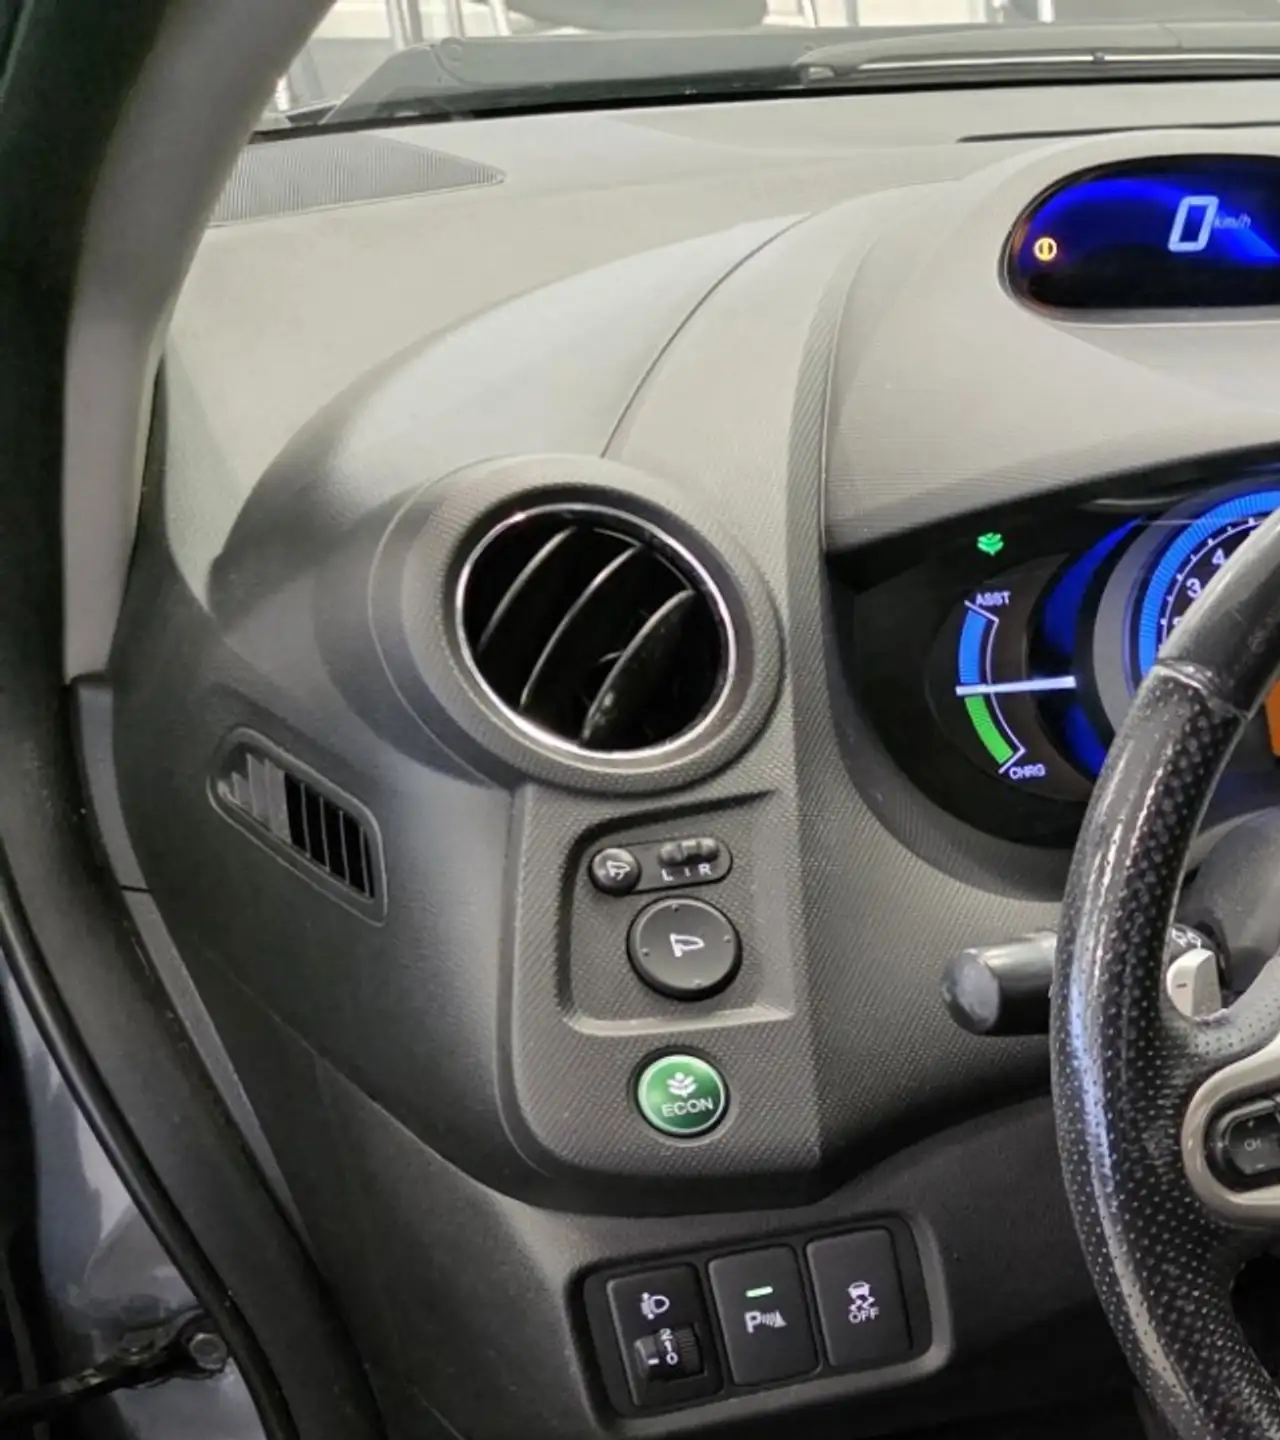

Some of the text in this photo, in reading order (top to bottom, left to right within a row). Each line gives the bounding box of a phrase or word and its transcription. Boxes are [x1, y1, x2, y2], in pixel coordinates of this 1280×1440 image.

[1167, 195, 1220, 253] 0
[1185, 577, 1202, 599] 3
[975, 590, 1011, 607] ASST
[1009, 763, 1046, 780] CHRG
[661, 868, 675, 882] L
[698, 863, 712, 877] R
[661, 1096, 714, 1118] ECON
[1243, 1137, 1263, 1152] CH
[848, 1307, 880, 1325] OFF
[659, 1328, 673, 1341] 2
[664, 1341, 675, 1352] 1
[666, 1352, 679, 1365] 0
